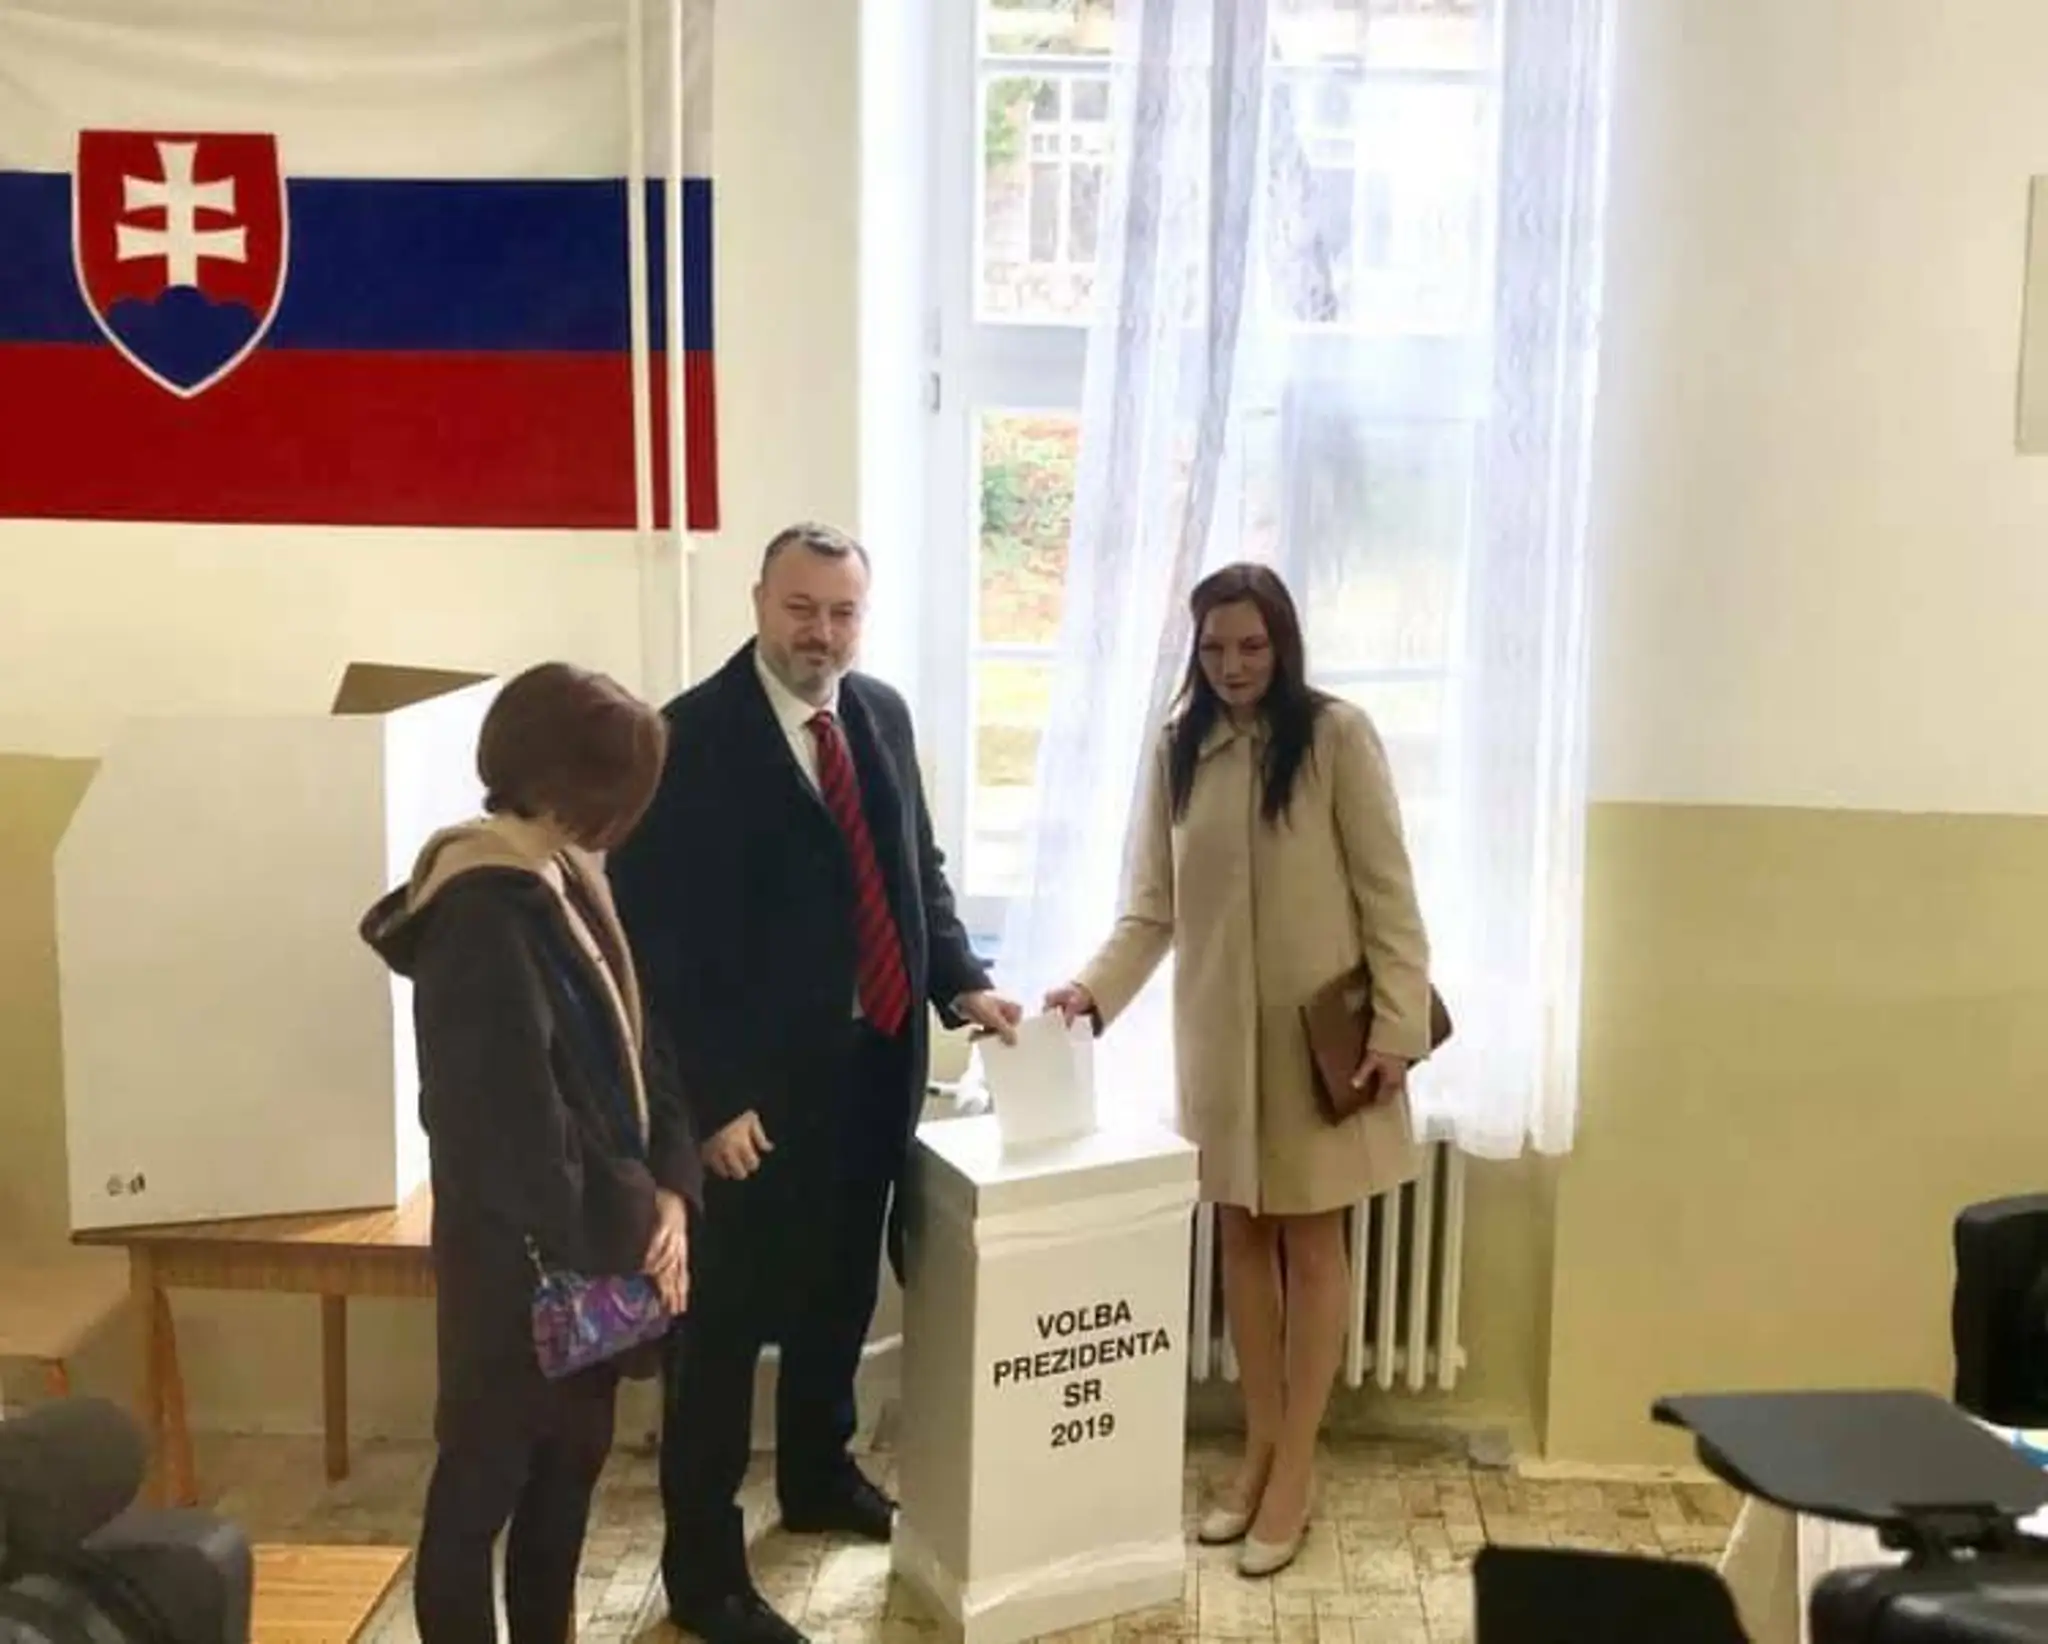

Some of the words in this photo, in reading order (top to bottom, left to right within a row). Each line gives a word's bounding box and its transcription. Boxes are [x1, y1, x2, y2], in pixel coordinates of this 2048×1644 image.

[992, 1327, 1171, 1387] PREZIDENTA
[1063, 1379, 1102, 1408] SR
[1050, 1413, 1116, 1448] 2019
